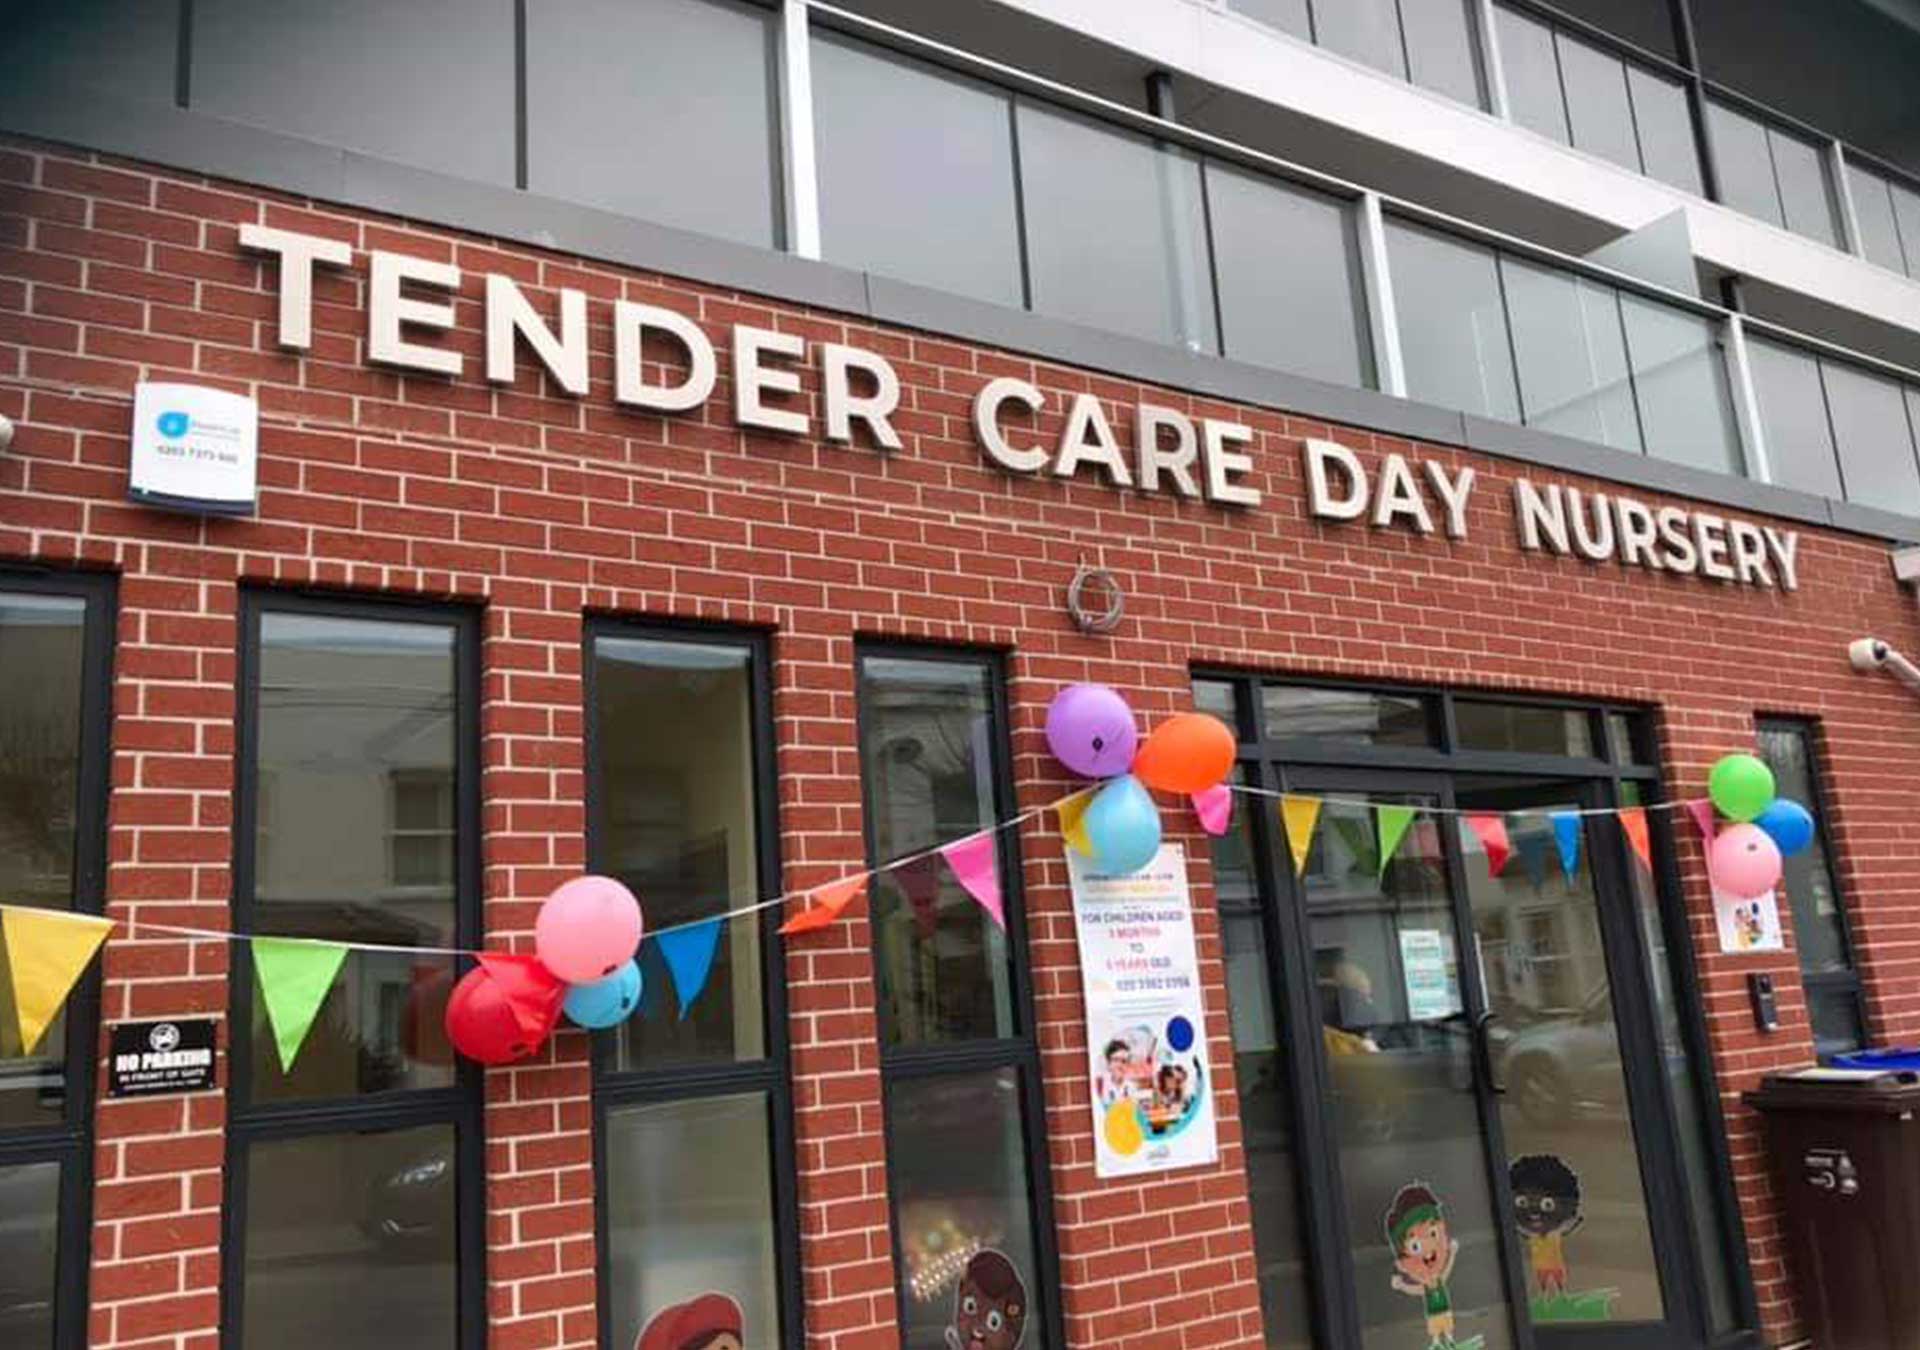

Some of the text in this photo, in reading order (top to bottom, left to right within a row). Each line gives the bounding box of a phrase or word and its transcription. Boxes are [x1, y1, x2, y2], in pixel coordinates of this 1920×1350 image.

[238, 223, 1798, 591] TENDER CARE DAY NURSERY
[1082, 911, 1184, 924] FOR CHILDREN AGED
[1117, 927, 1161, 938] MONTHS
[1130, 943, 1145, 953] TO
[1115, 957, 1148, 970] YEARS
[1150, 957, 1171, 968] OLD
[116, 1048, 211, 1072] NO PARKING
